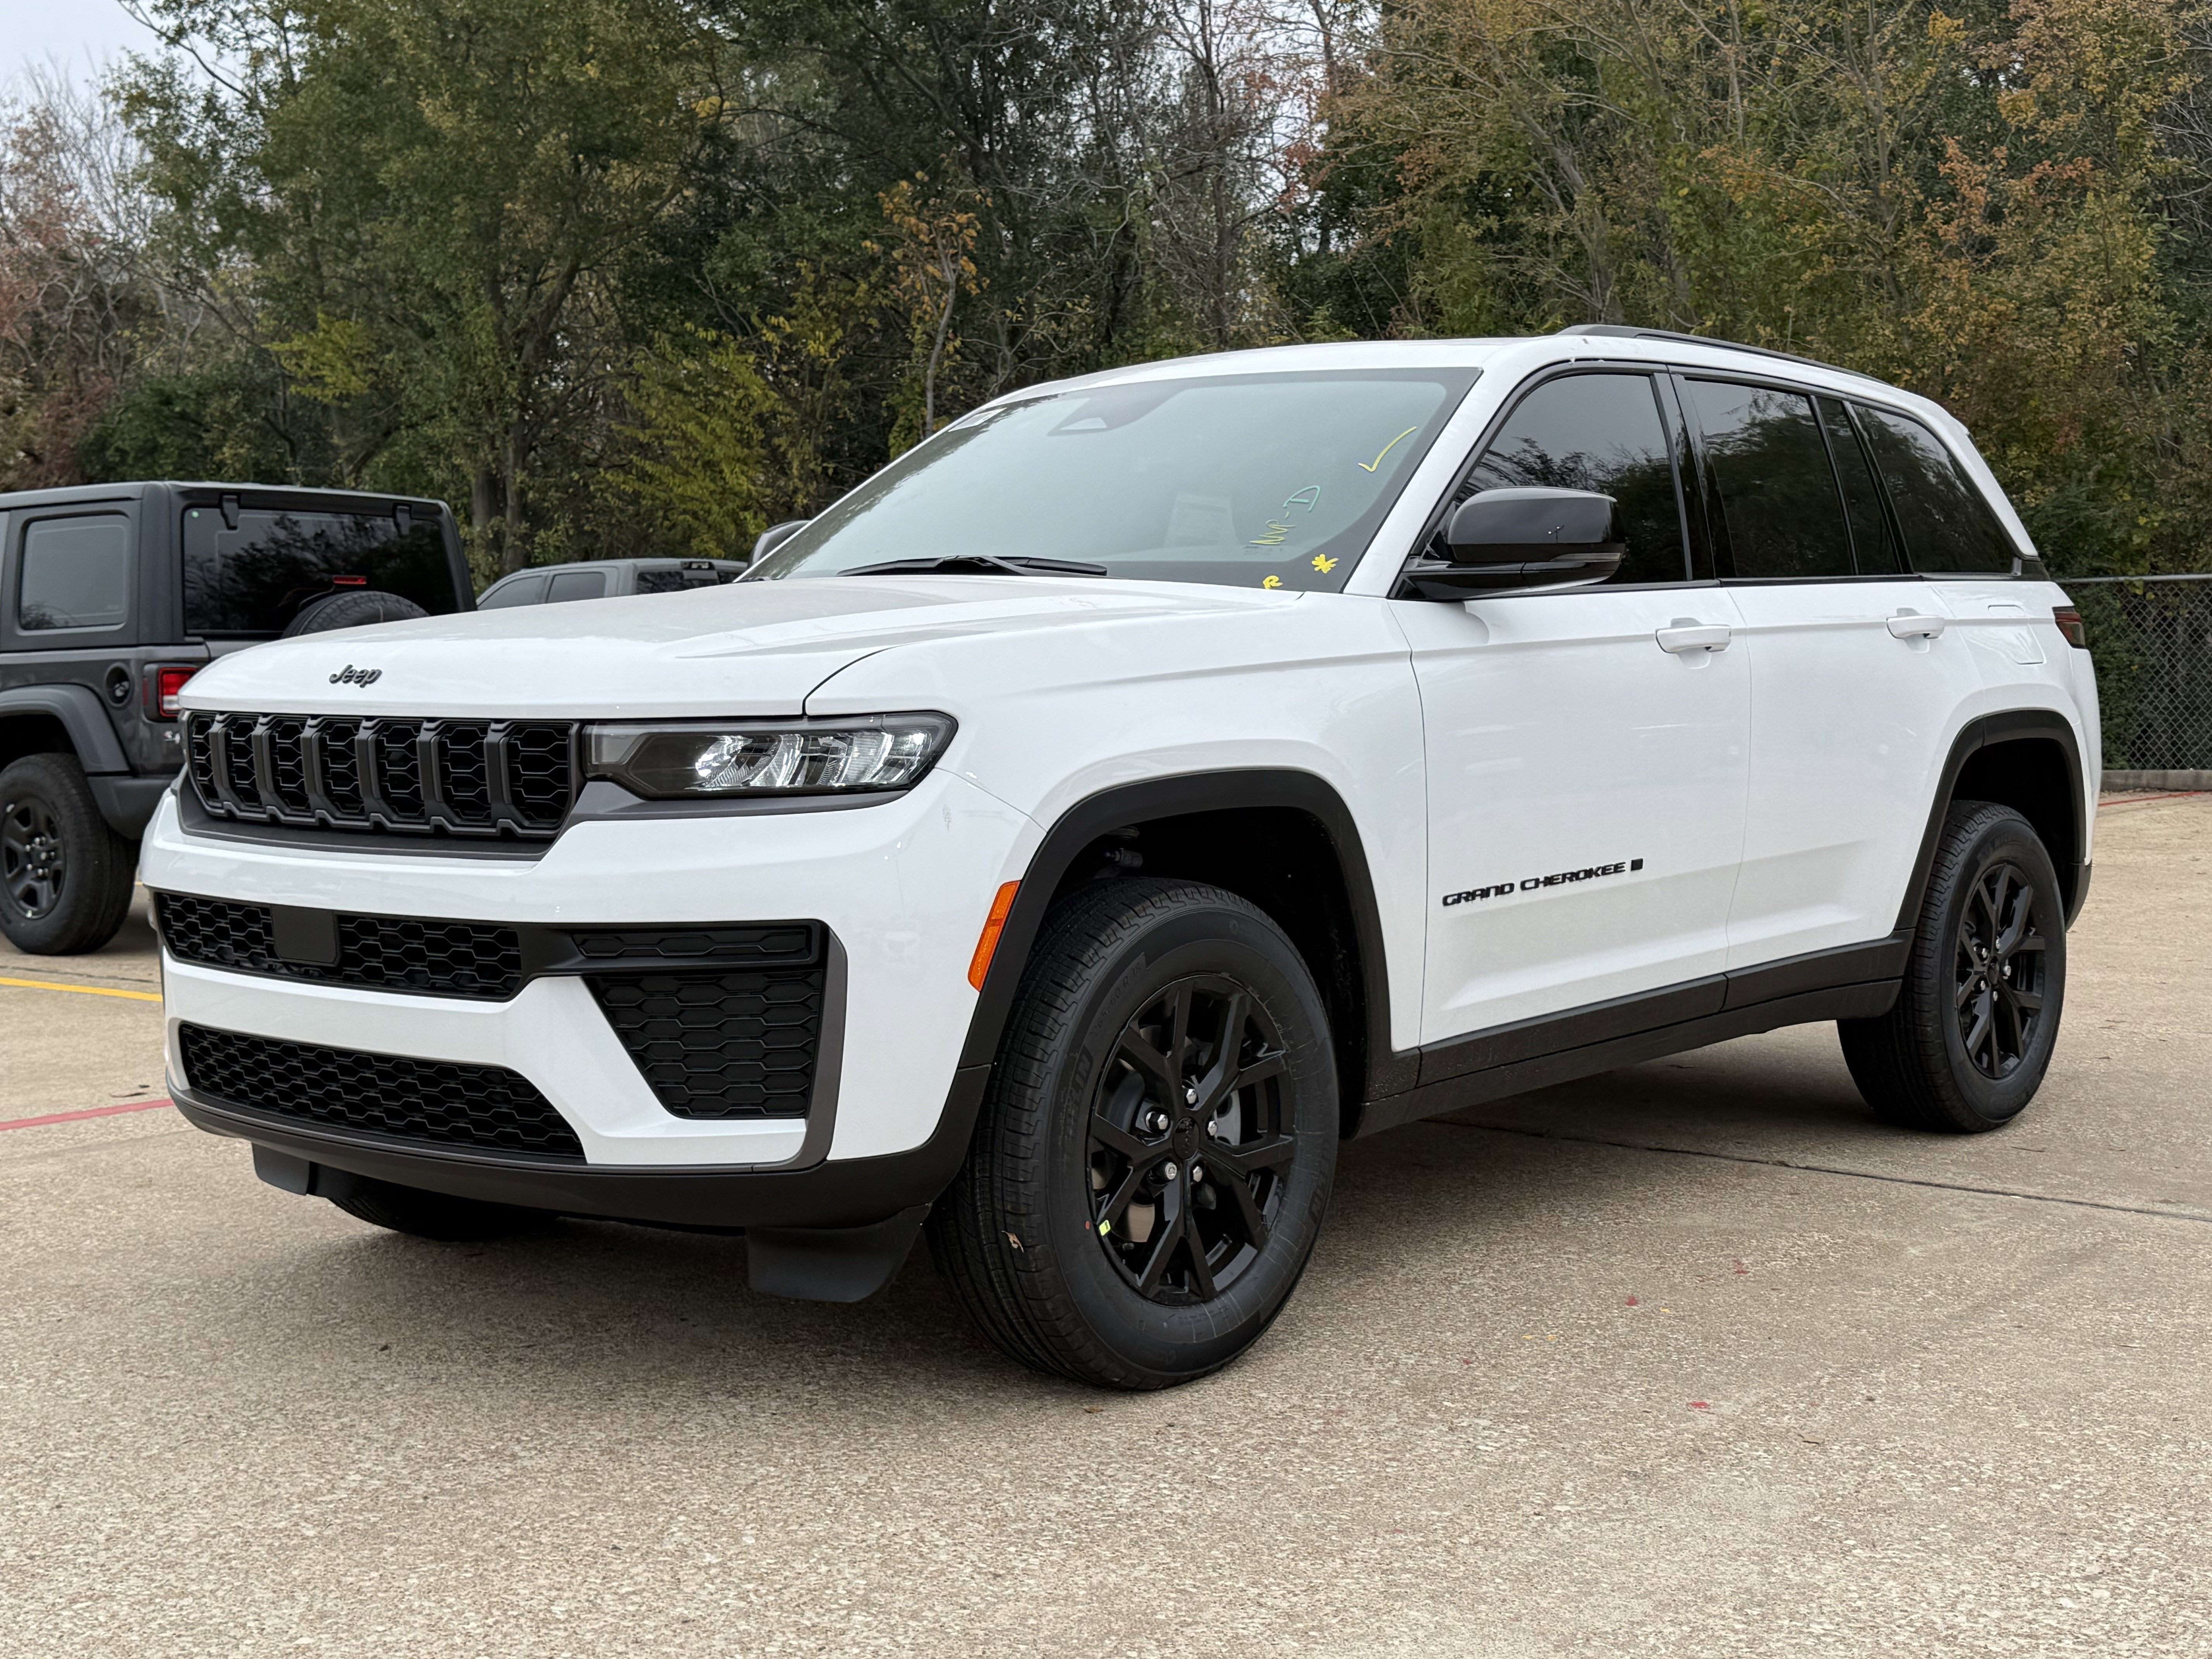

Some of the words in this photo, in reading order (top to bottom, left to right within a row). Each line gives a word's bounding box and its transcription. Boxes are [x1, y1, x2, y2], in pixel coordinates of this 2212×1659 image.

[329, 664, 383, 688] Jeep
[1443, 883, 1515, 907] GRAND
[1520, 862, 1626, 891] CHEROKEE
